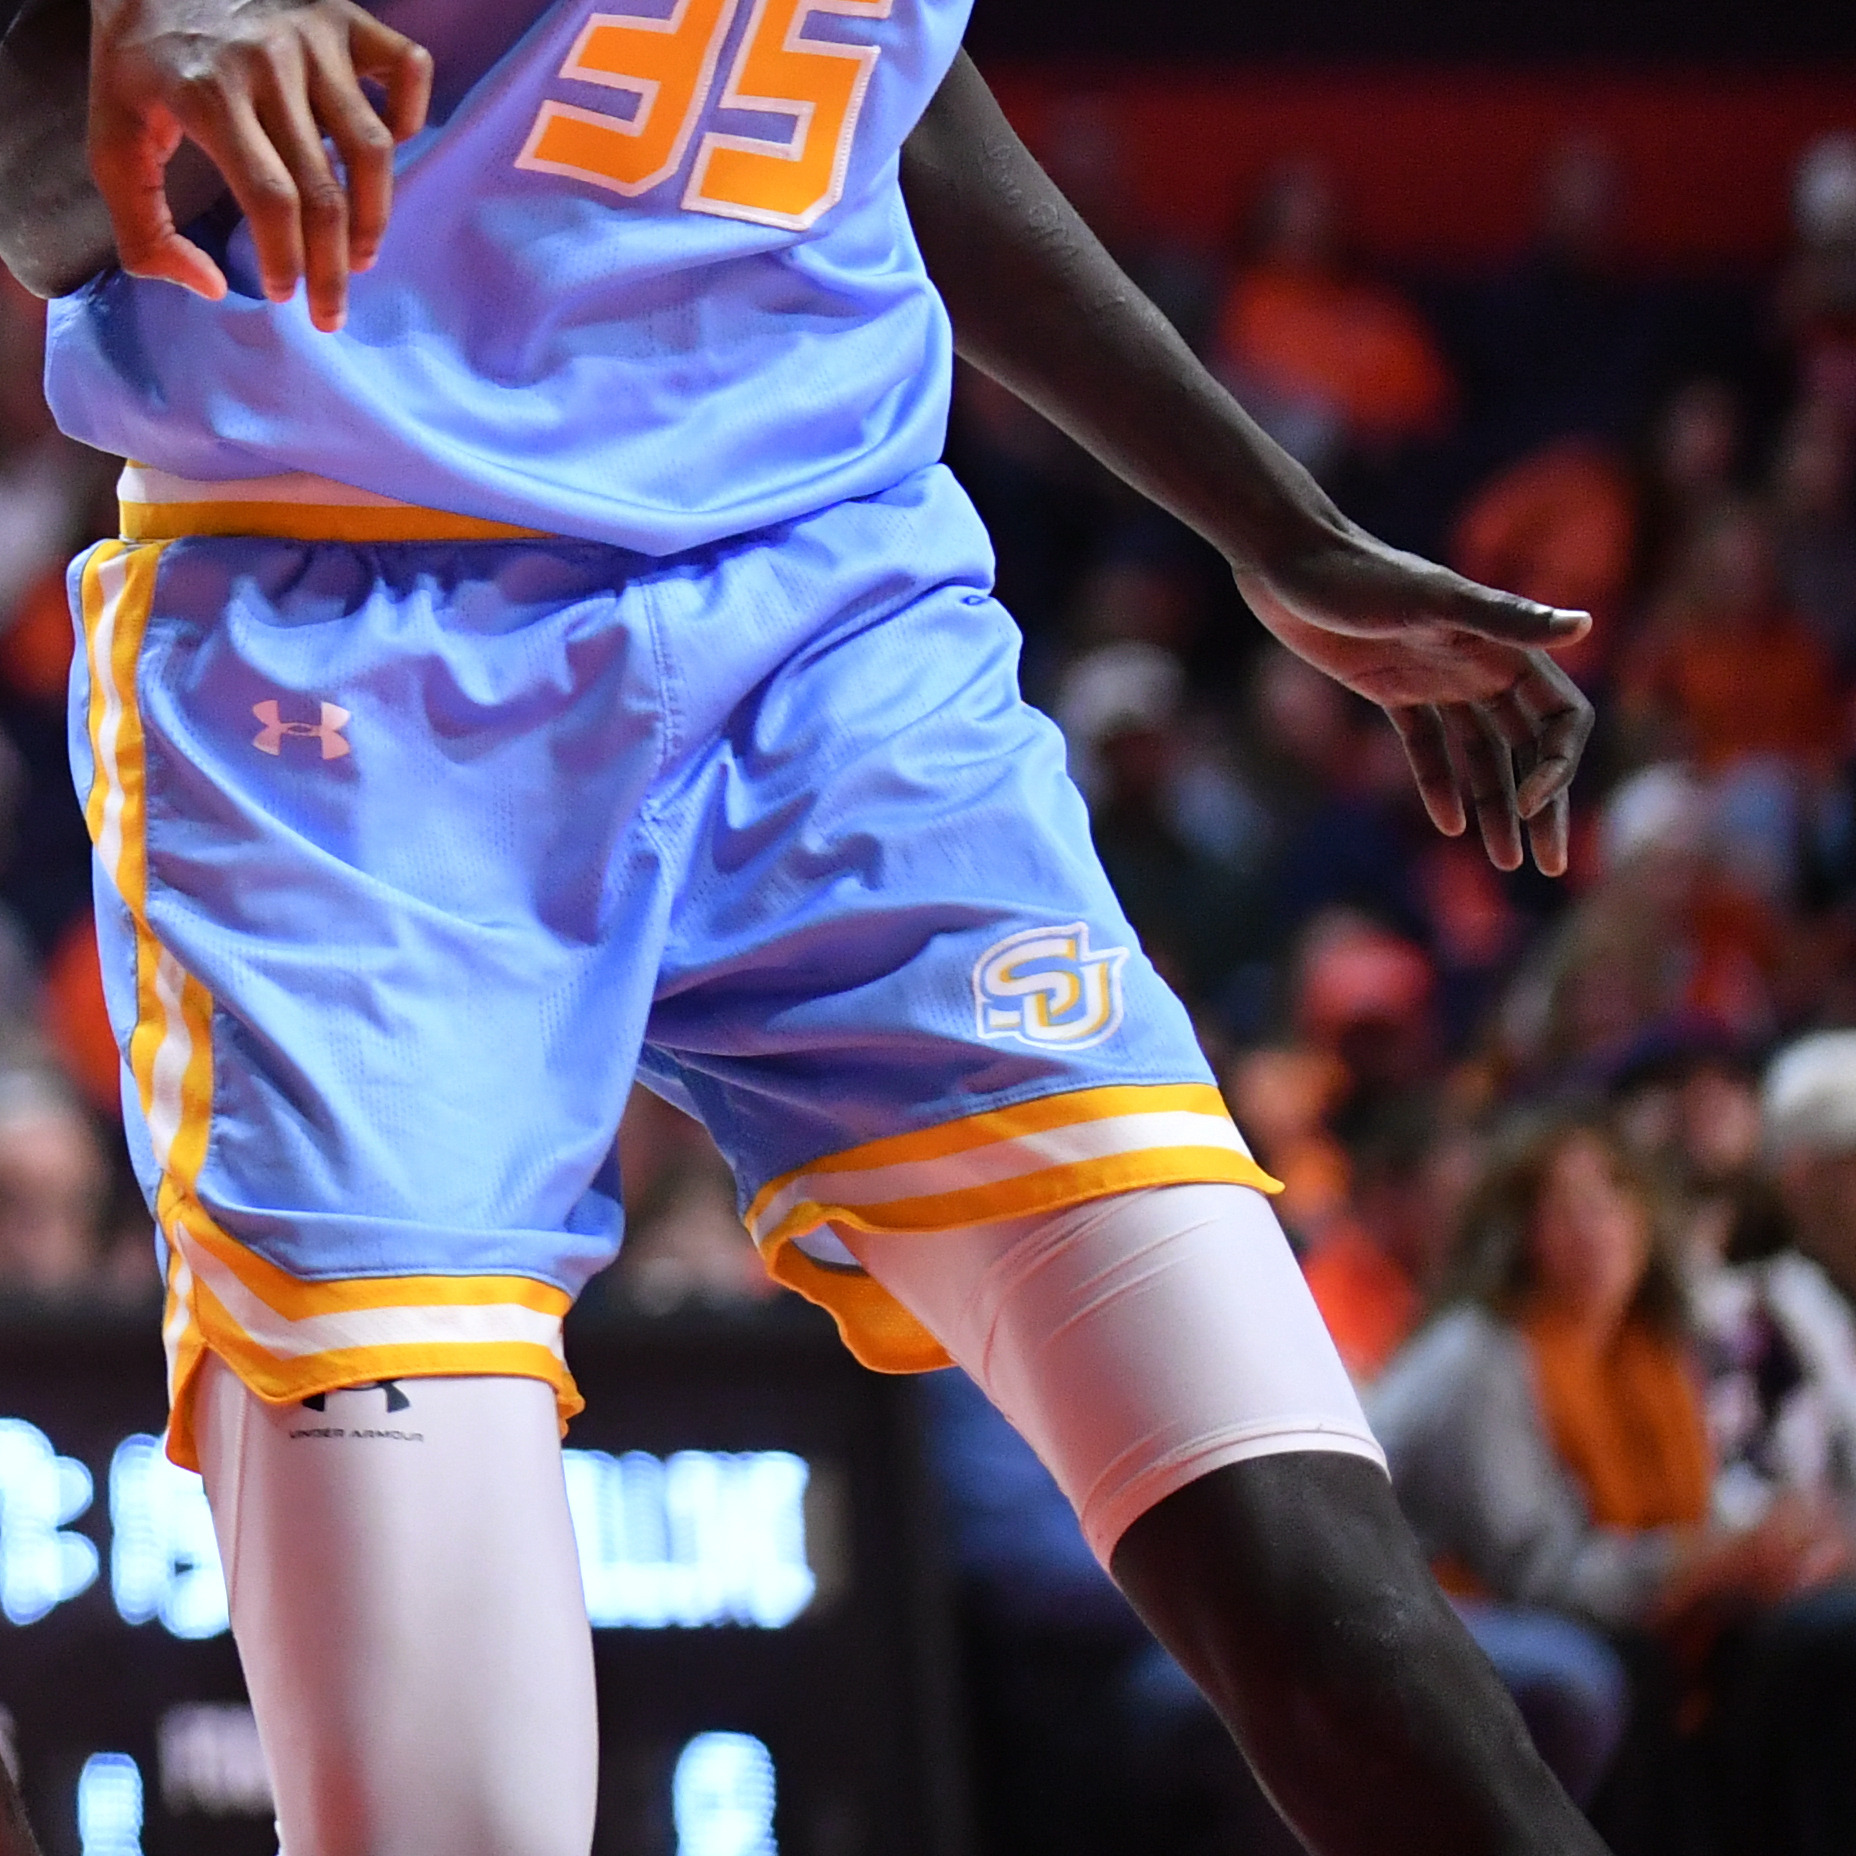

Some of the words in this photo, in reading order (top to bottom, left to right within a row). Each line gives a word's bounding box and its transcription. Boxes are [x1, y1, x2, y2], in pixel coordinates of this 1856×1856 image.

[973, 921, 1130, 1051] SU
[289, 1428, 346, 1440] UNDER
[348, 1429, 425, 1443] ARMOUR
